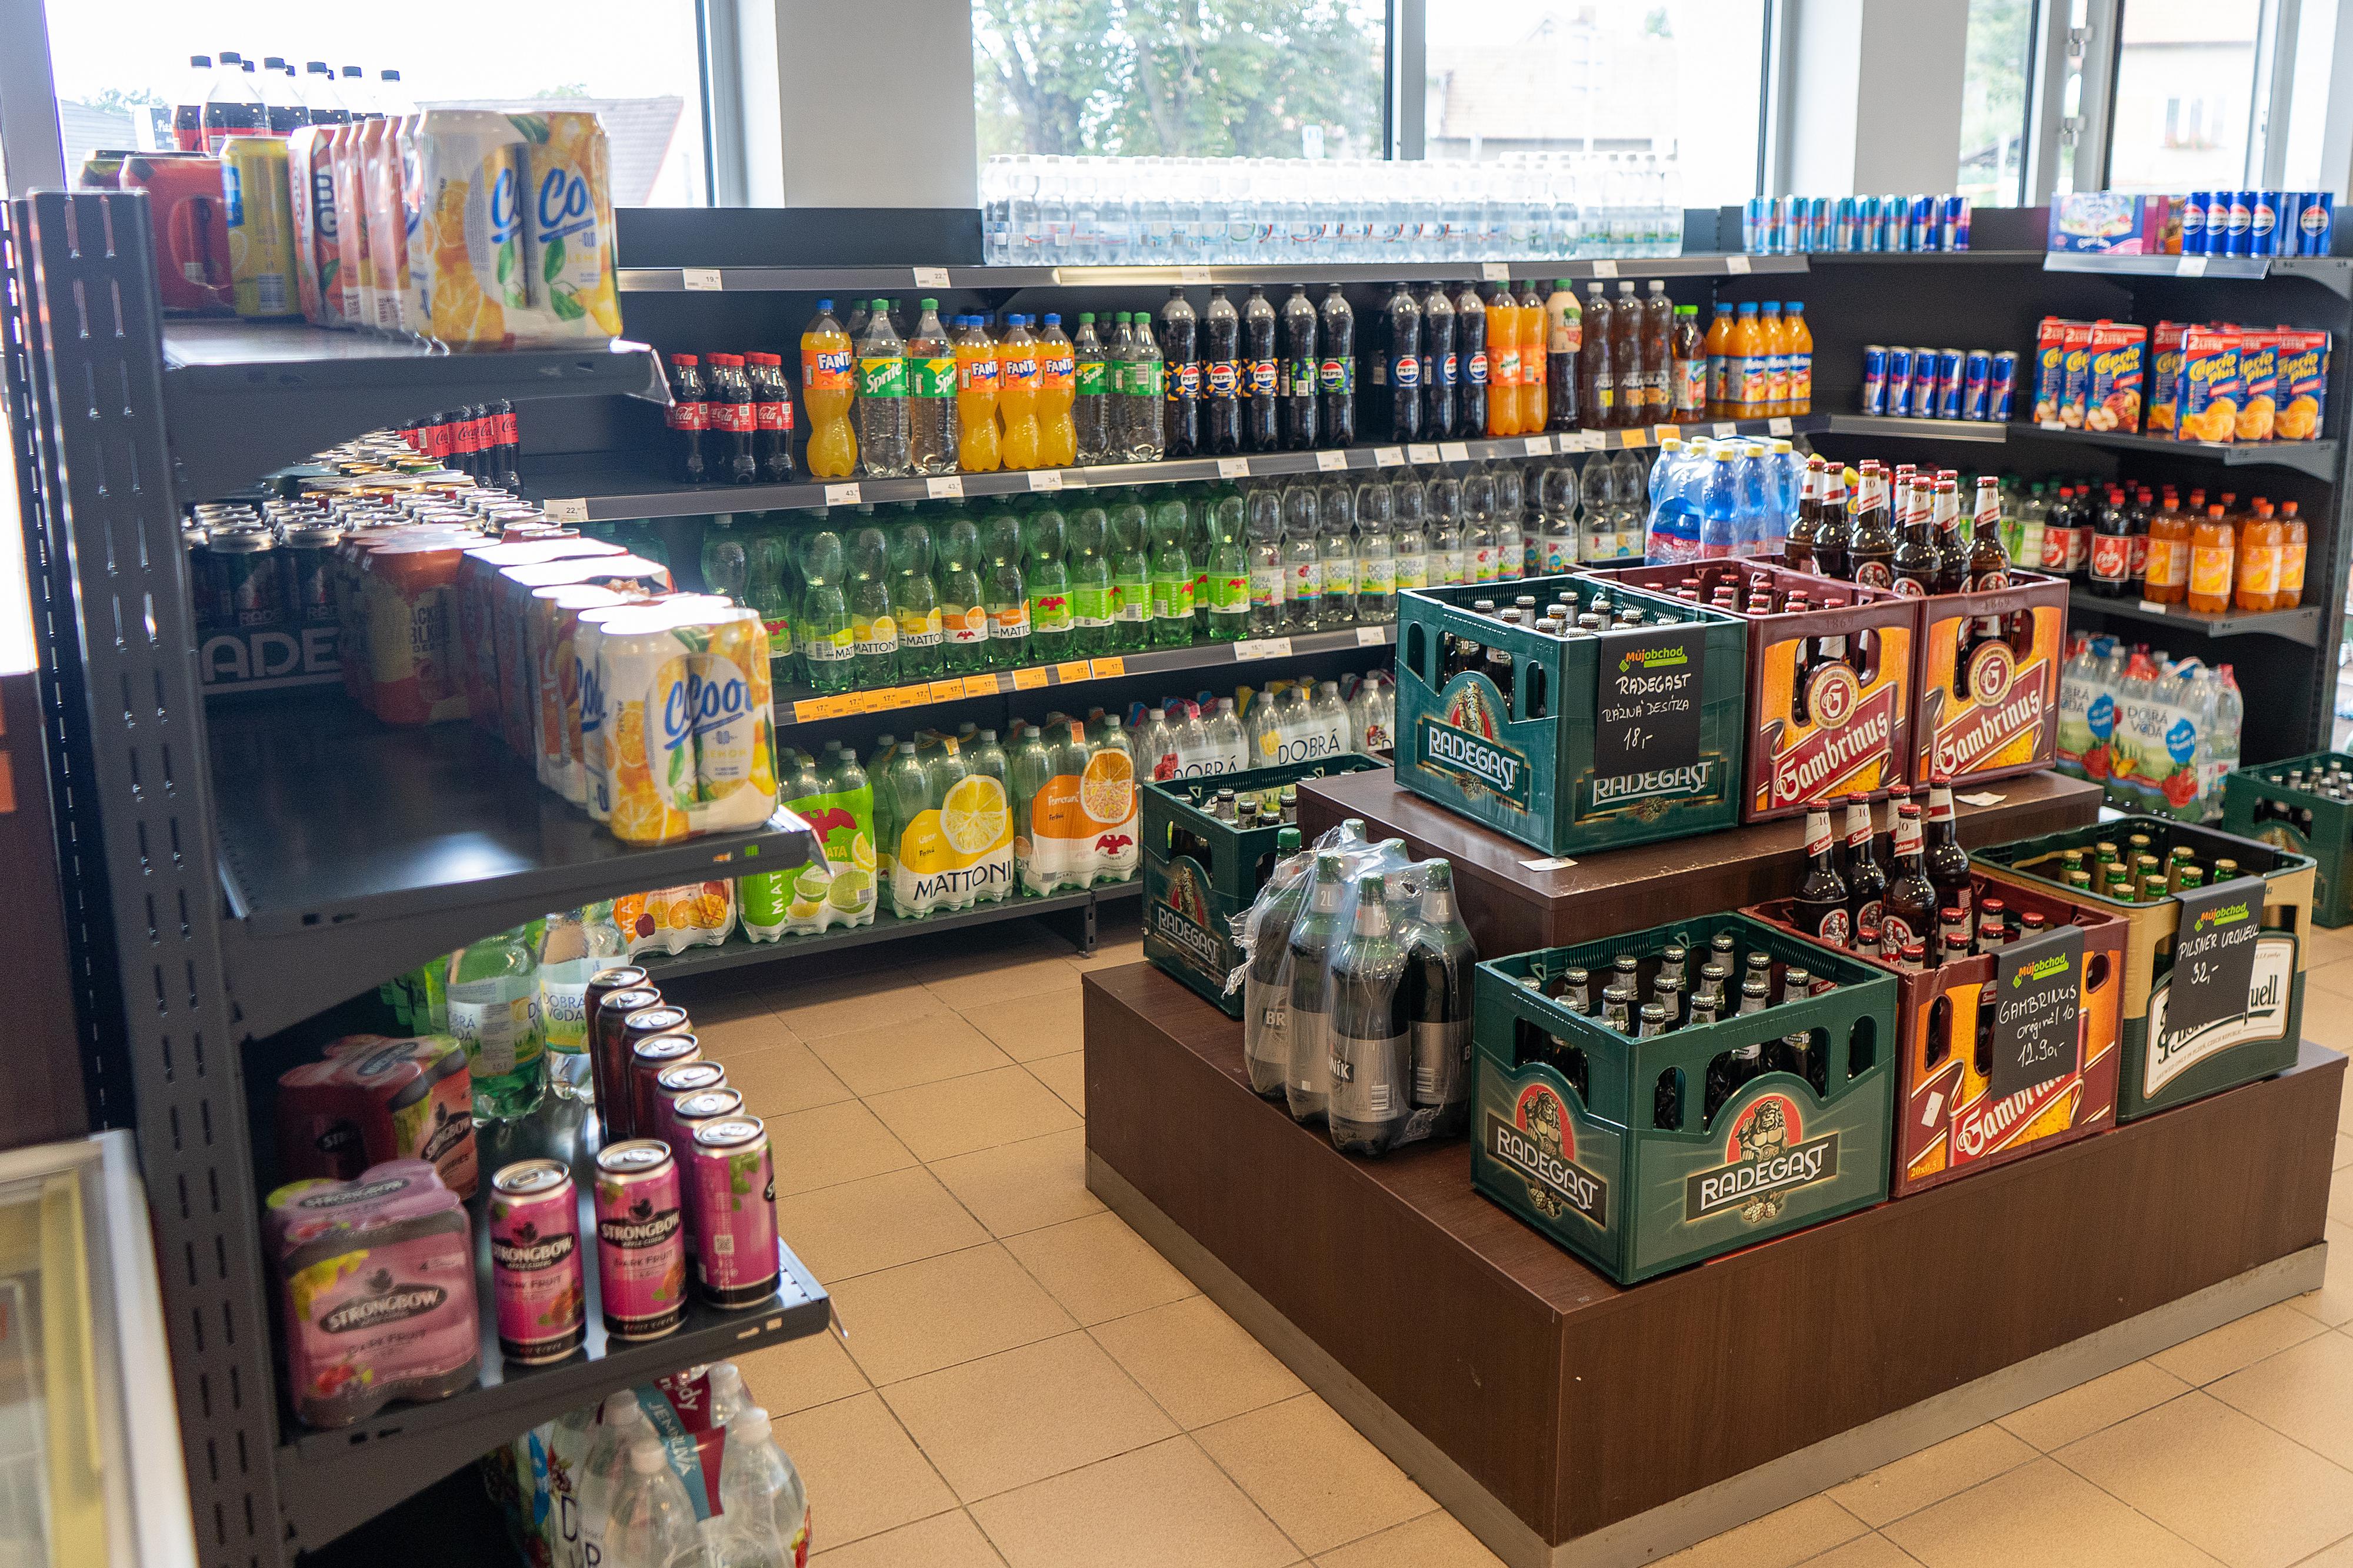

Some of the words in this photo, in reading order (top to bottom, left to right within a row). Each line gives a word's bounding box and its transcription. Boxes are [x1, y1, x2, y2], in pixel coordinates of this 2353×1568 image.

[866, 363, 902, 394] Sprite
[2112, 360, 2140, 379] plus
[2189, 355, 2237, 382] Caprio
[2209, 366, 2237, 386] plus
[1865, 479, 1875, 489] 10
[1912, 495, 1921, 503] 10
[854, 640, 896, 653] MATTONI
[1460, 640, 1469, 650] 10
[1615, 673, 1692, 696] RADEGAST
[1934, 686, 2041, 776] Gambrinus
[2130, 722, 2163, 739] VODA
[1278, 728, 1342, 766] DOBRÁ
[1775, 711, 1890, 802] Gambrinus
[1428, 724, 1517, 792] RADEGAST
[1818, 816, 1829, 825] 10
[1859, 808, 1869, 817] 10
[1898, 821, 1909, 831] 10
[913, 860, 1011, 900] MATTONI
[1320, 890, 1333, 906] 2L
[1437, 899, 1449, 916] 2L
[1157, 906, 1220, 966] RADEGAST
[2178, 935, 2218, 962] PILSNER
[2221, 922, 2260, 950] URQUELL
[547, 1008, 585, 1022] VODA
[1998, 985, 2077, 1025] GAMBRINUS
[1615, 1020, 1625, 1031] 10
[1801, 1032, 1810, 1045] 10
[1497, 1125, 1599, 1210] RADEGAST
[1700, 1142, 1830, 1211] RADEGAST
[600, 1210, 681, 1241] STRONGBOW
[328, 1289, 440, 1331] STRONGBOW
